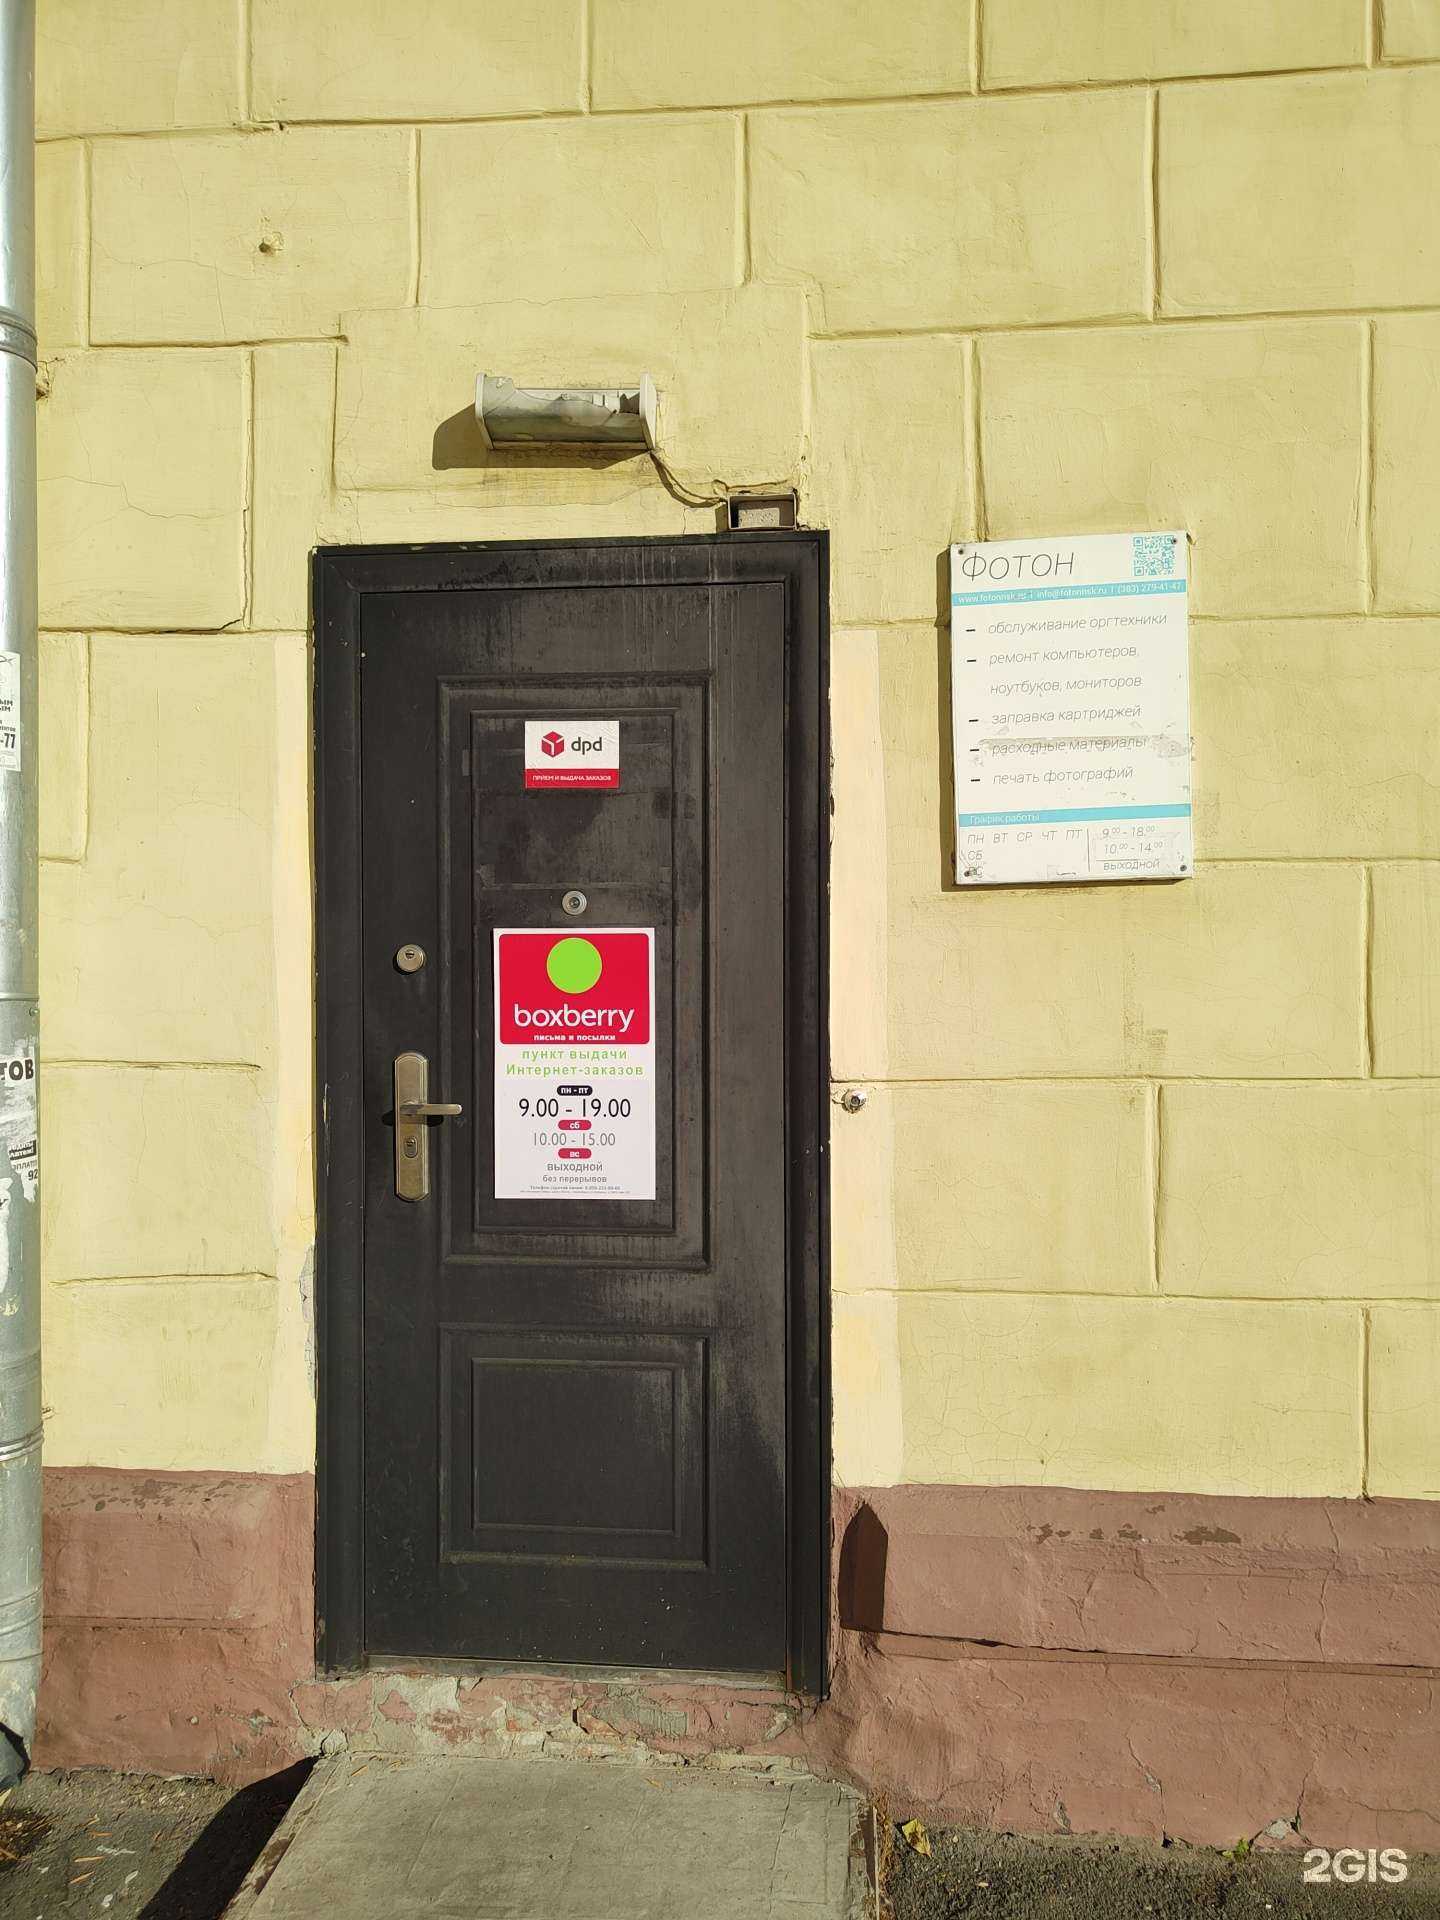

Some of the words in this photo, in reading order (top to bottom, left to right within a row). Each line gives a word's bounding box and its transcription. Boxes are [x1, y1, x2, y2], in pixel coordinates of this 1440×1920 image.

[961, 552, 1075, 581] ФОТОН
[988, 617, 1087, 636] обслуживание
[1089, 613, 1168, 629] оргтехники
[989, 651, 1040, 667] ремонт
[990, 678, 1063, 697] ноутбуков,
[1066, 675, 1143, 690] мониторов
[991, 711, 1056, 727] заправка
[1058, 704, 1142, 724] картриджей
[571, 737, 603, 755] dpd
[992, 739, 1067, 757] расходные
[1069, 737, 1147, 752] материалы
[993, 771, 1040, 785] печать
[1043, 766, 1134, 785] фотографий
[1005, 813, 1040, 825] работы
[967, 833, 985, 845] ПН
[993, 832, 1009, 844] ВТ
[1016, 831, 1033, 843] СР
[1041, 830, 1058, 841] ЧТ
[1066, 829, 1083, 841] ПТ
[967, 849, 983, 861] СБ
[1103, 858, 1160, 872] выходной
[514, 1003, 635, 1033] boxberry
[522, 1050, 564, 1061] пункт
[569, 1050, 628, 1060] выдачи
[506, 1064, 644, 1077] Интернет-заказов
[518, 1098, 559, 1118] 9.00
[582, 1098, 631, 1118] 19.00
[569, 1121, 580, 1129] сб
[533, 1132, 567, 1146] 10.00
[582, 1132, 616, 1146] 15.00
[547, 1161, 603, 1173] выходной
[559, 1176, 607, 1184] перерывов
